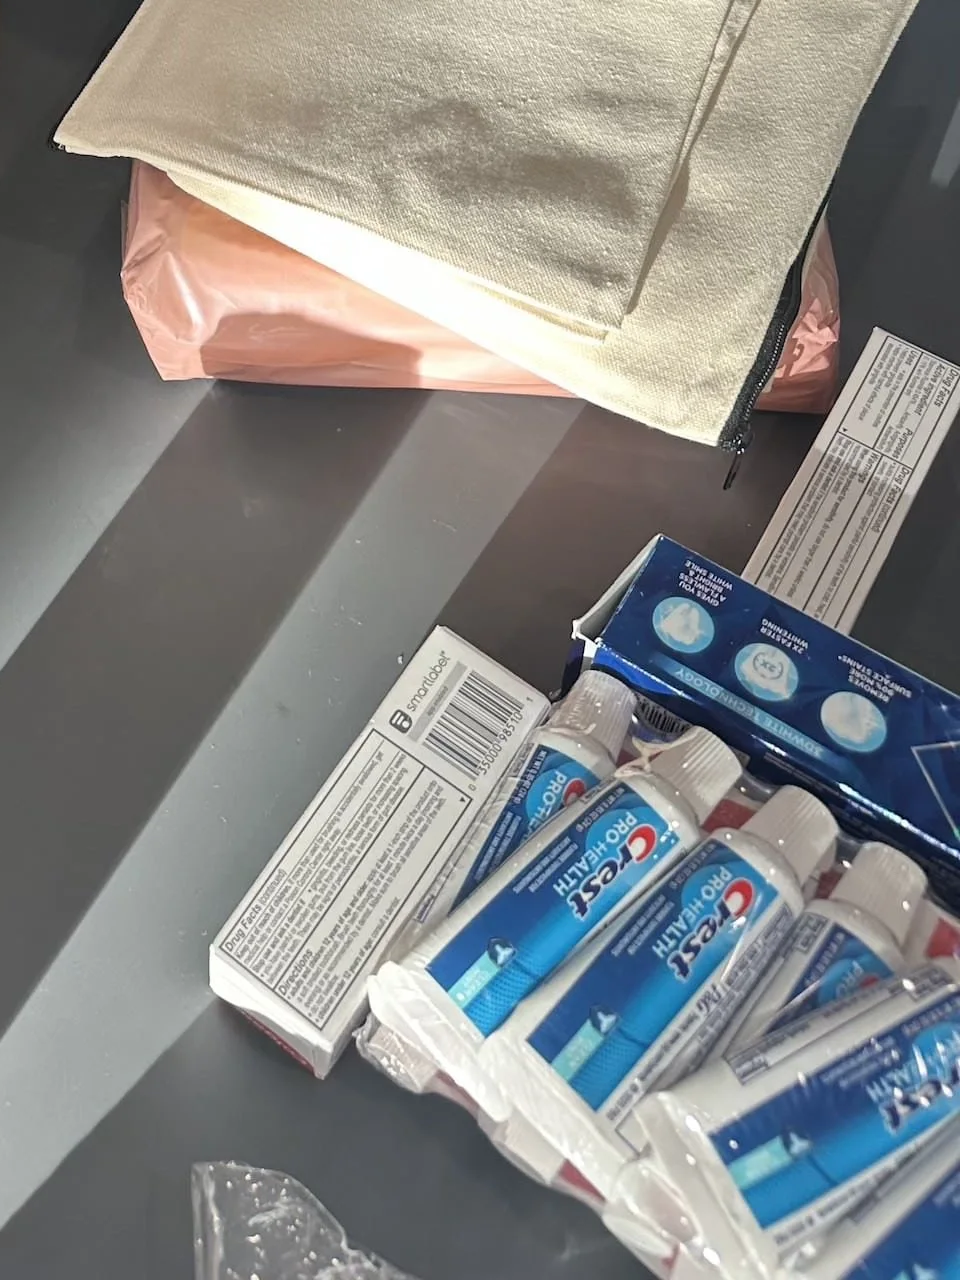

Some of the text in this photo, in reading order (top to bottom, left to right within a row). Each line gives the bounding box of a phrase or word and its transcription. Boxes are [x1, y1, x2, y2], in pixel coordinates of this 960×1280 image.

[932, 367, 959, 408] Drug Facts
[890, 427, 913, 459] Purposes
[855, 451, 878, 484] Warnings
[894, 466, 910, 485] Drug
[885, 484, 901, 505] Facts
[677, 571, 726, 602] A FLAWLESS
[684, 559, 733, 591] WHITE SMILE
[695, 572, 723, 593] BRIGHT
[678, 579, 720, 607] GIVES YOU
[759, 625, 804, 654] 2X FASTER
[760, 617, 809, 648] WHITENING
[404, 652, 450, 713] smartlabel
[846, 674, 890, 702] REMOVES
[848, 667, 875, 686] MORE
[871, 670, 913, 698] SURFACE
[477, 742, 503, 775] 35000
[497, 710, 524, 742] 98510
[562, 819, 663, 922] Crest
[223, 866, 288, 953] Drug Facts (continued)
[662, 873, 760, 982] Crest
[277, 946, 313, 996] Directions
